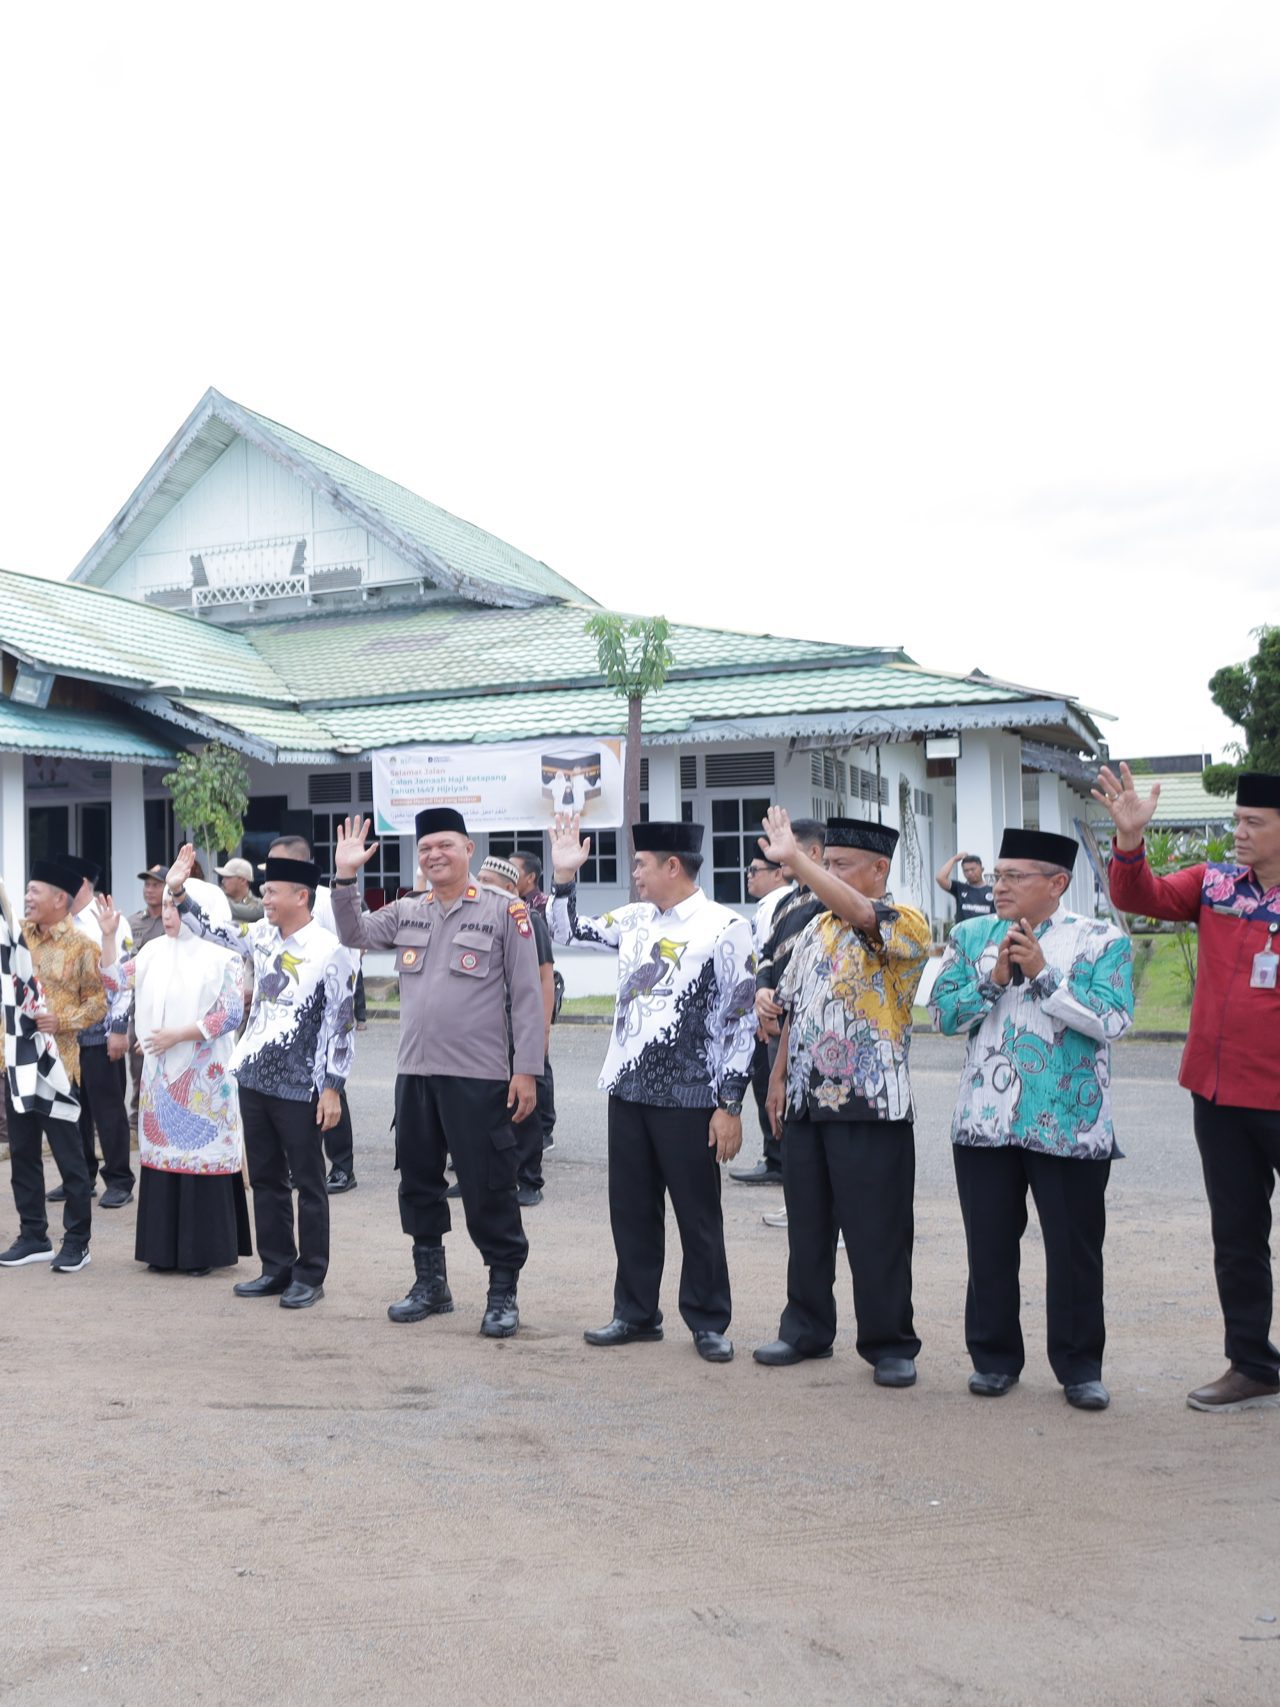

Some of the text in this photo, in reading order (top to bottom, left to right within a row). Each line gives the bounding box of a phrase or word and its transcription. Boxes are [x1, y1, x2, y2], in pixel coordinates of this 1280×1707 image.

[390, 766, 446, 777] Selamat Jalan
[448, 775, 464, 785] Haji
[466, 774, 507, 783] Ketapang
[390, 787, 415, 795] Tahun
[437, 784, 469, 794] Hijriyah
[460, 923, 494, 934] POLRI
